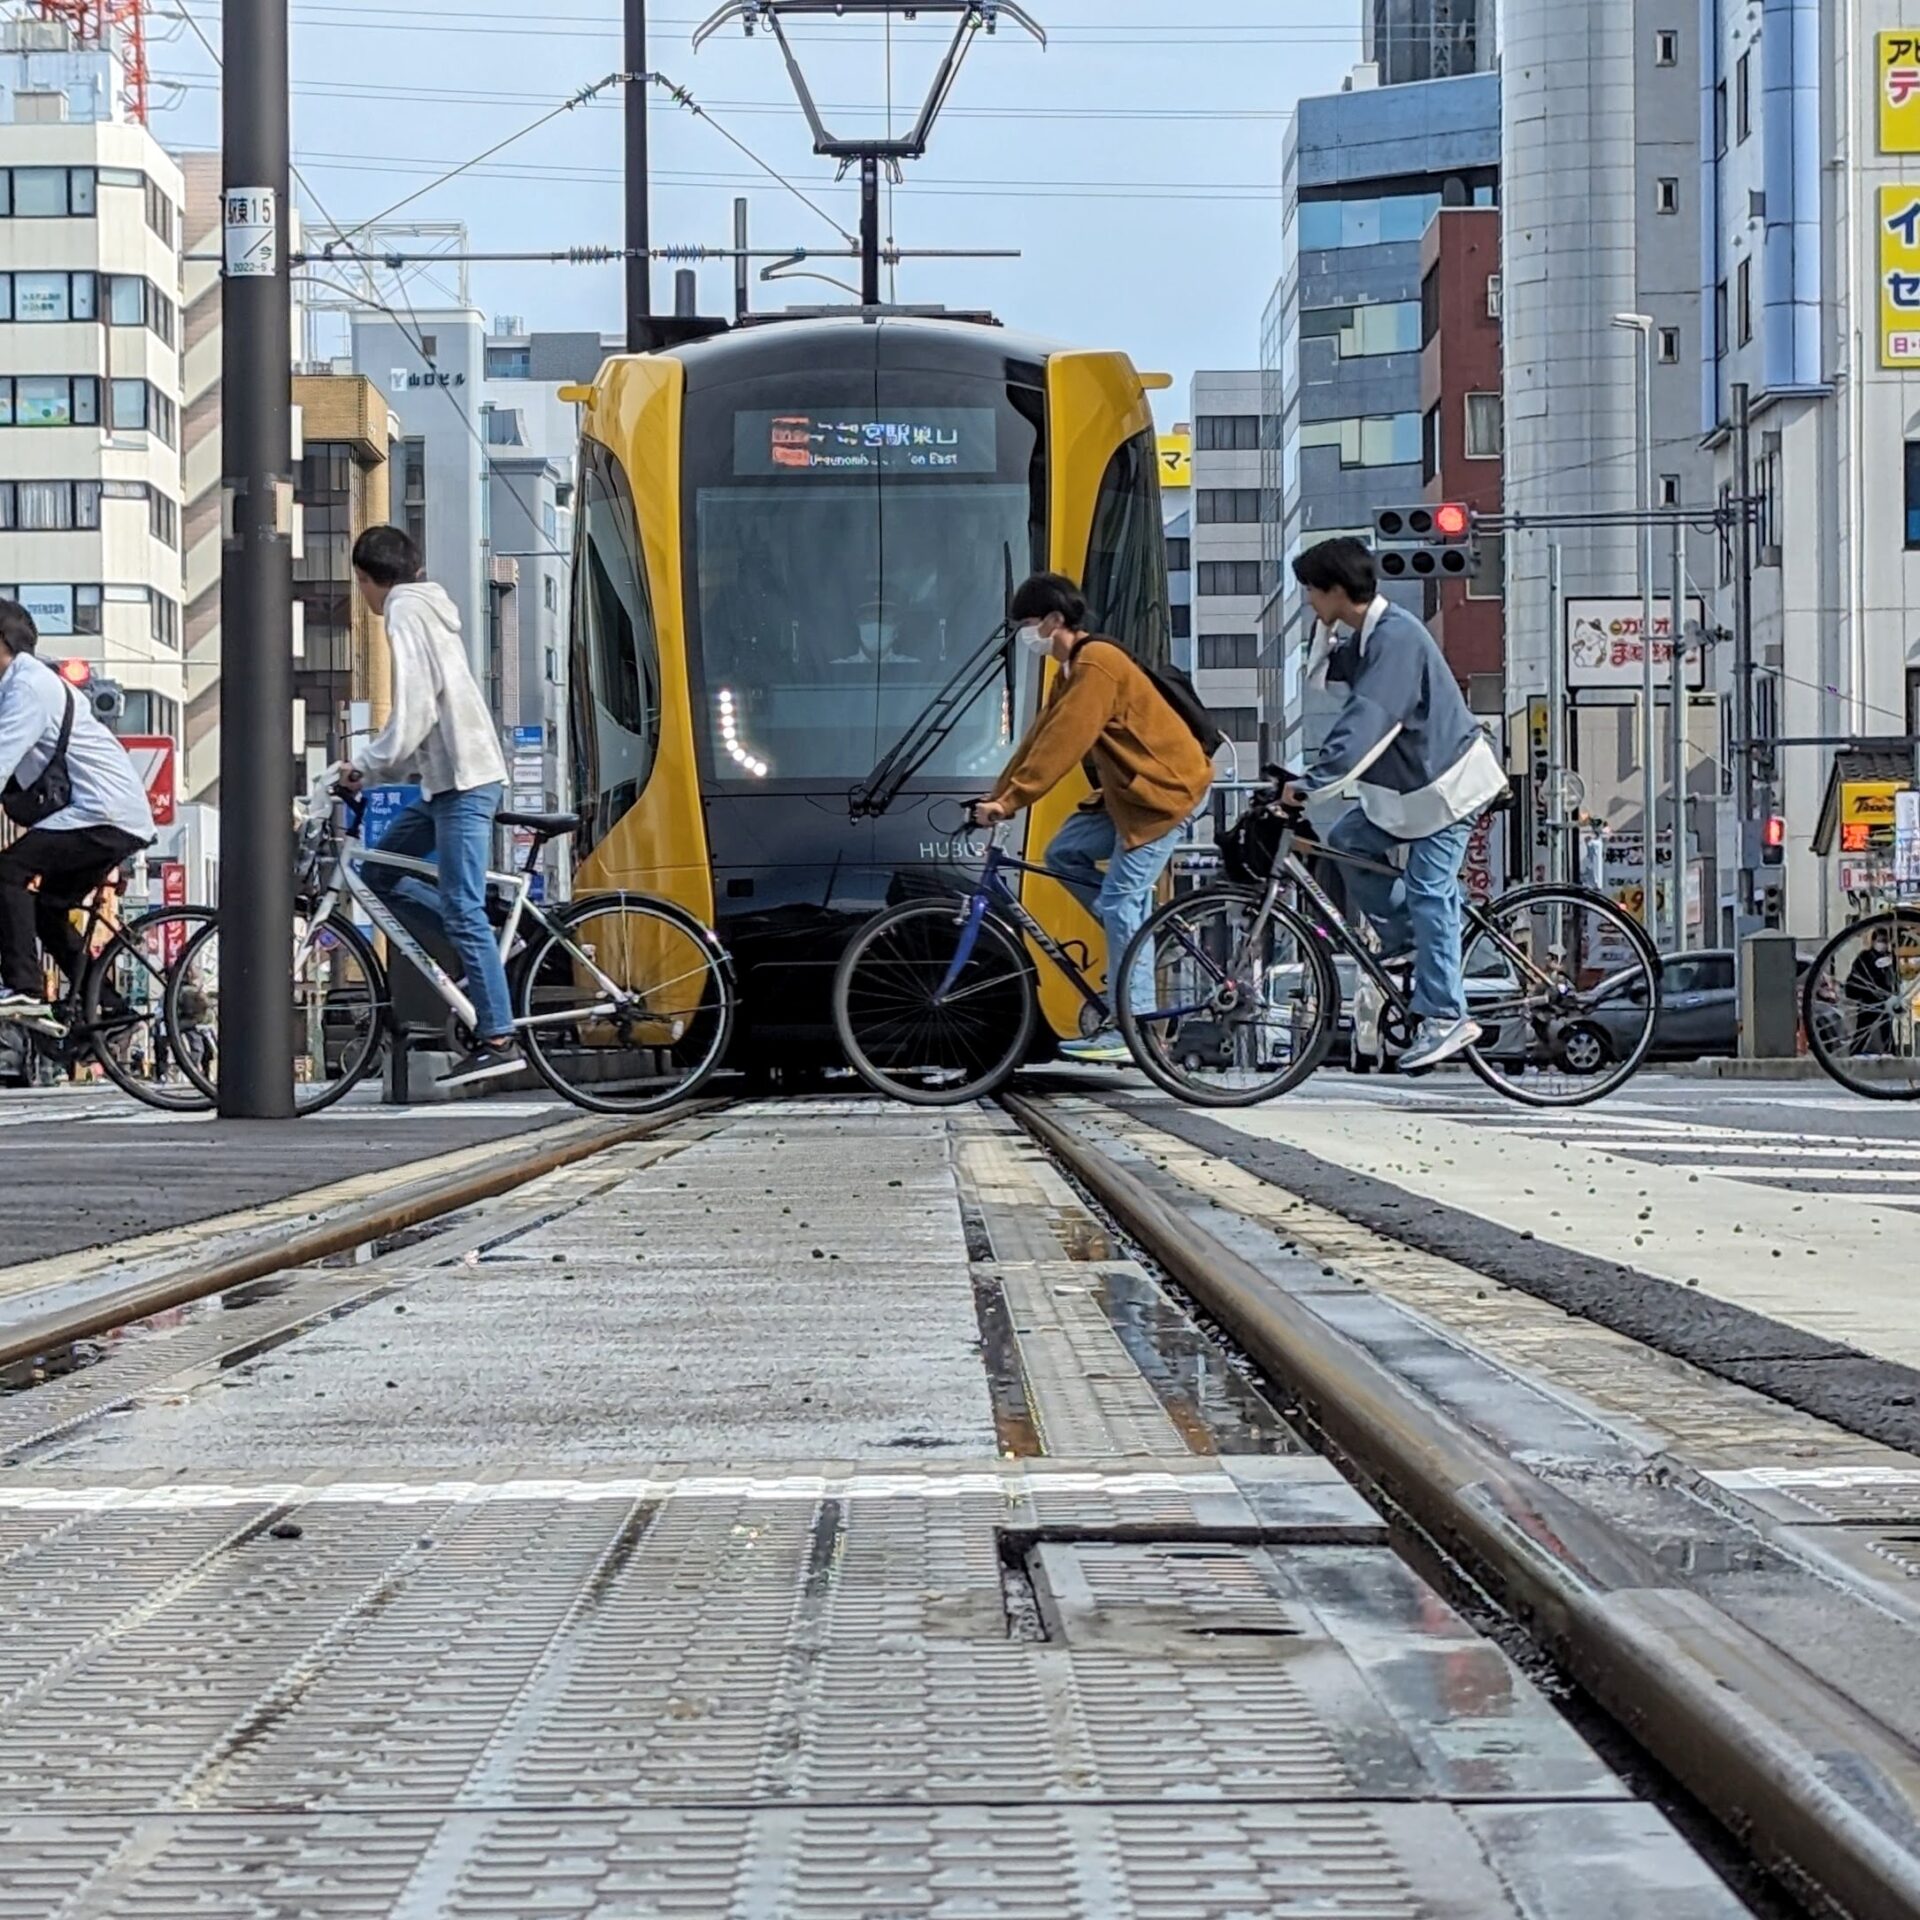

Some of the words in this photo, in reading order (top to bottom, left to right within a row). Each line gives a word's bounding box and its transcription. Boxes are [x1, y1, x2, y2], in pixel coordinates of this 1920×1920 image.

[408, 372, 465, 386] 山口ビル
[929, 453, 958, 465] East
